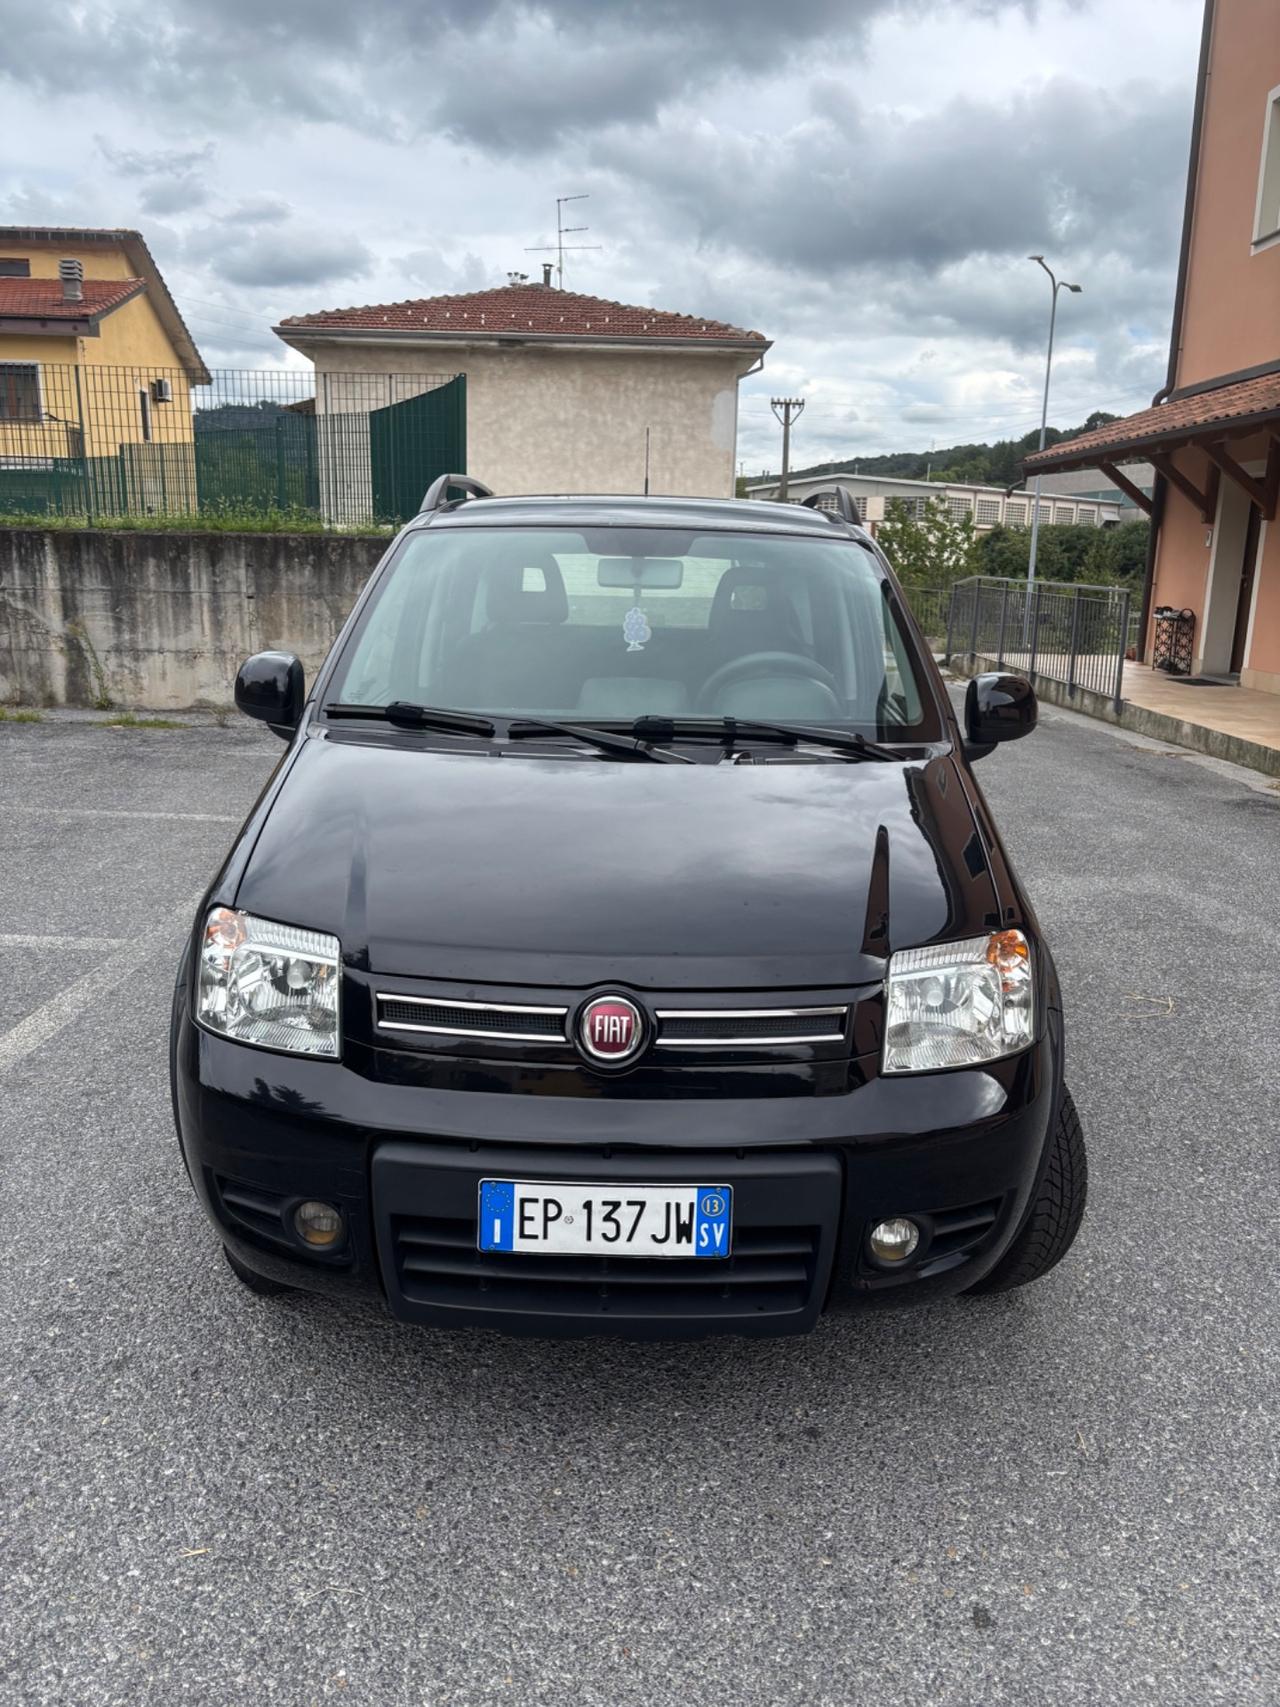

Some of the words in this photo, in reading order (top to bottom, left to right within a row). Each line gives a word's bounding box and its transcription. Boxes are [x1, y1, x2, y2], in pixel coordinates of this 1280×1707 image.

[595, 1014, 630, 1043] FIAT
[706, 1199, 719, 1213] 13
[493, 1218, 501, 1243] I
[518, 1197, 563, 1241] EP
[582, 1199, 647, 1243] 137
[650, 1201, 695, 1244] JW
[699, 1222, 725, 1248] SV
